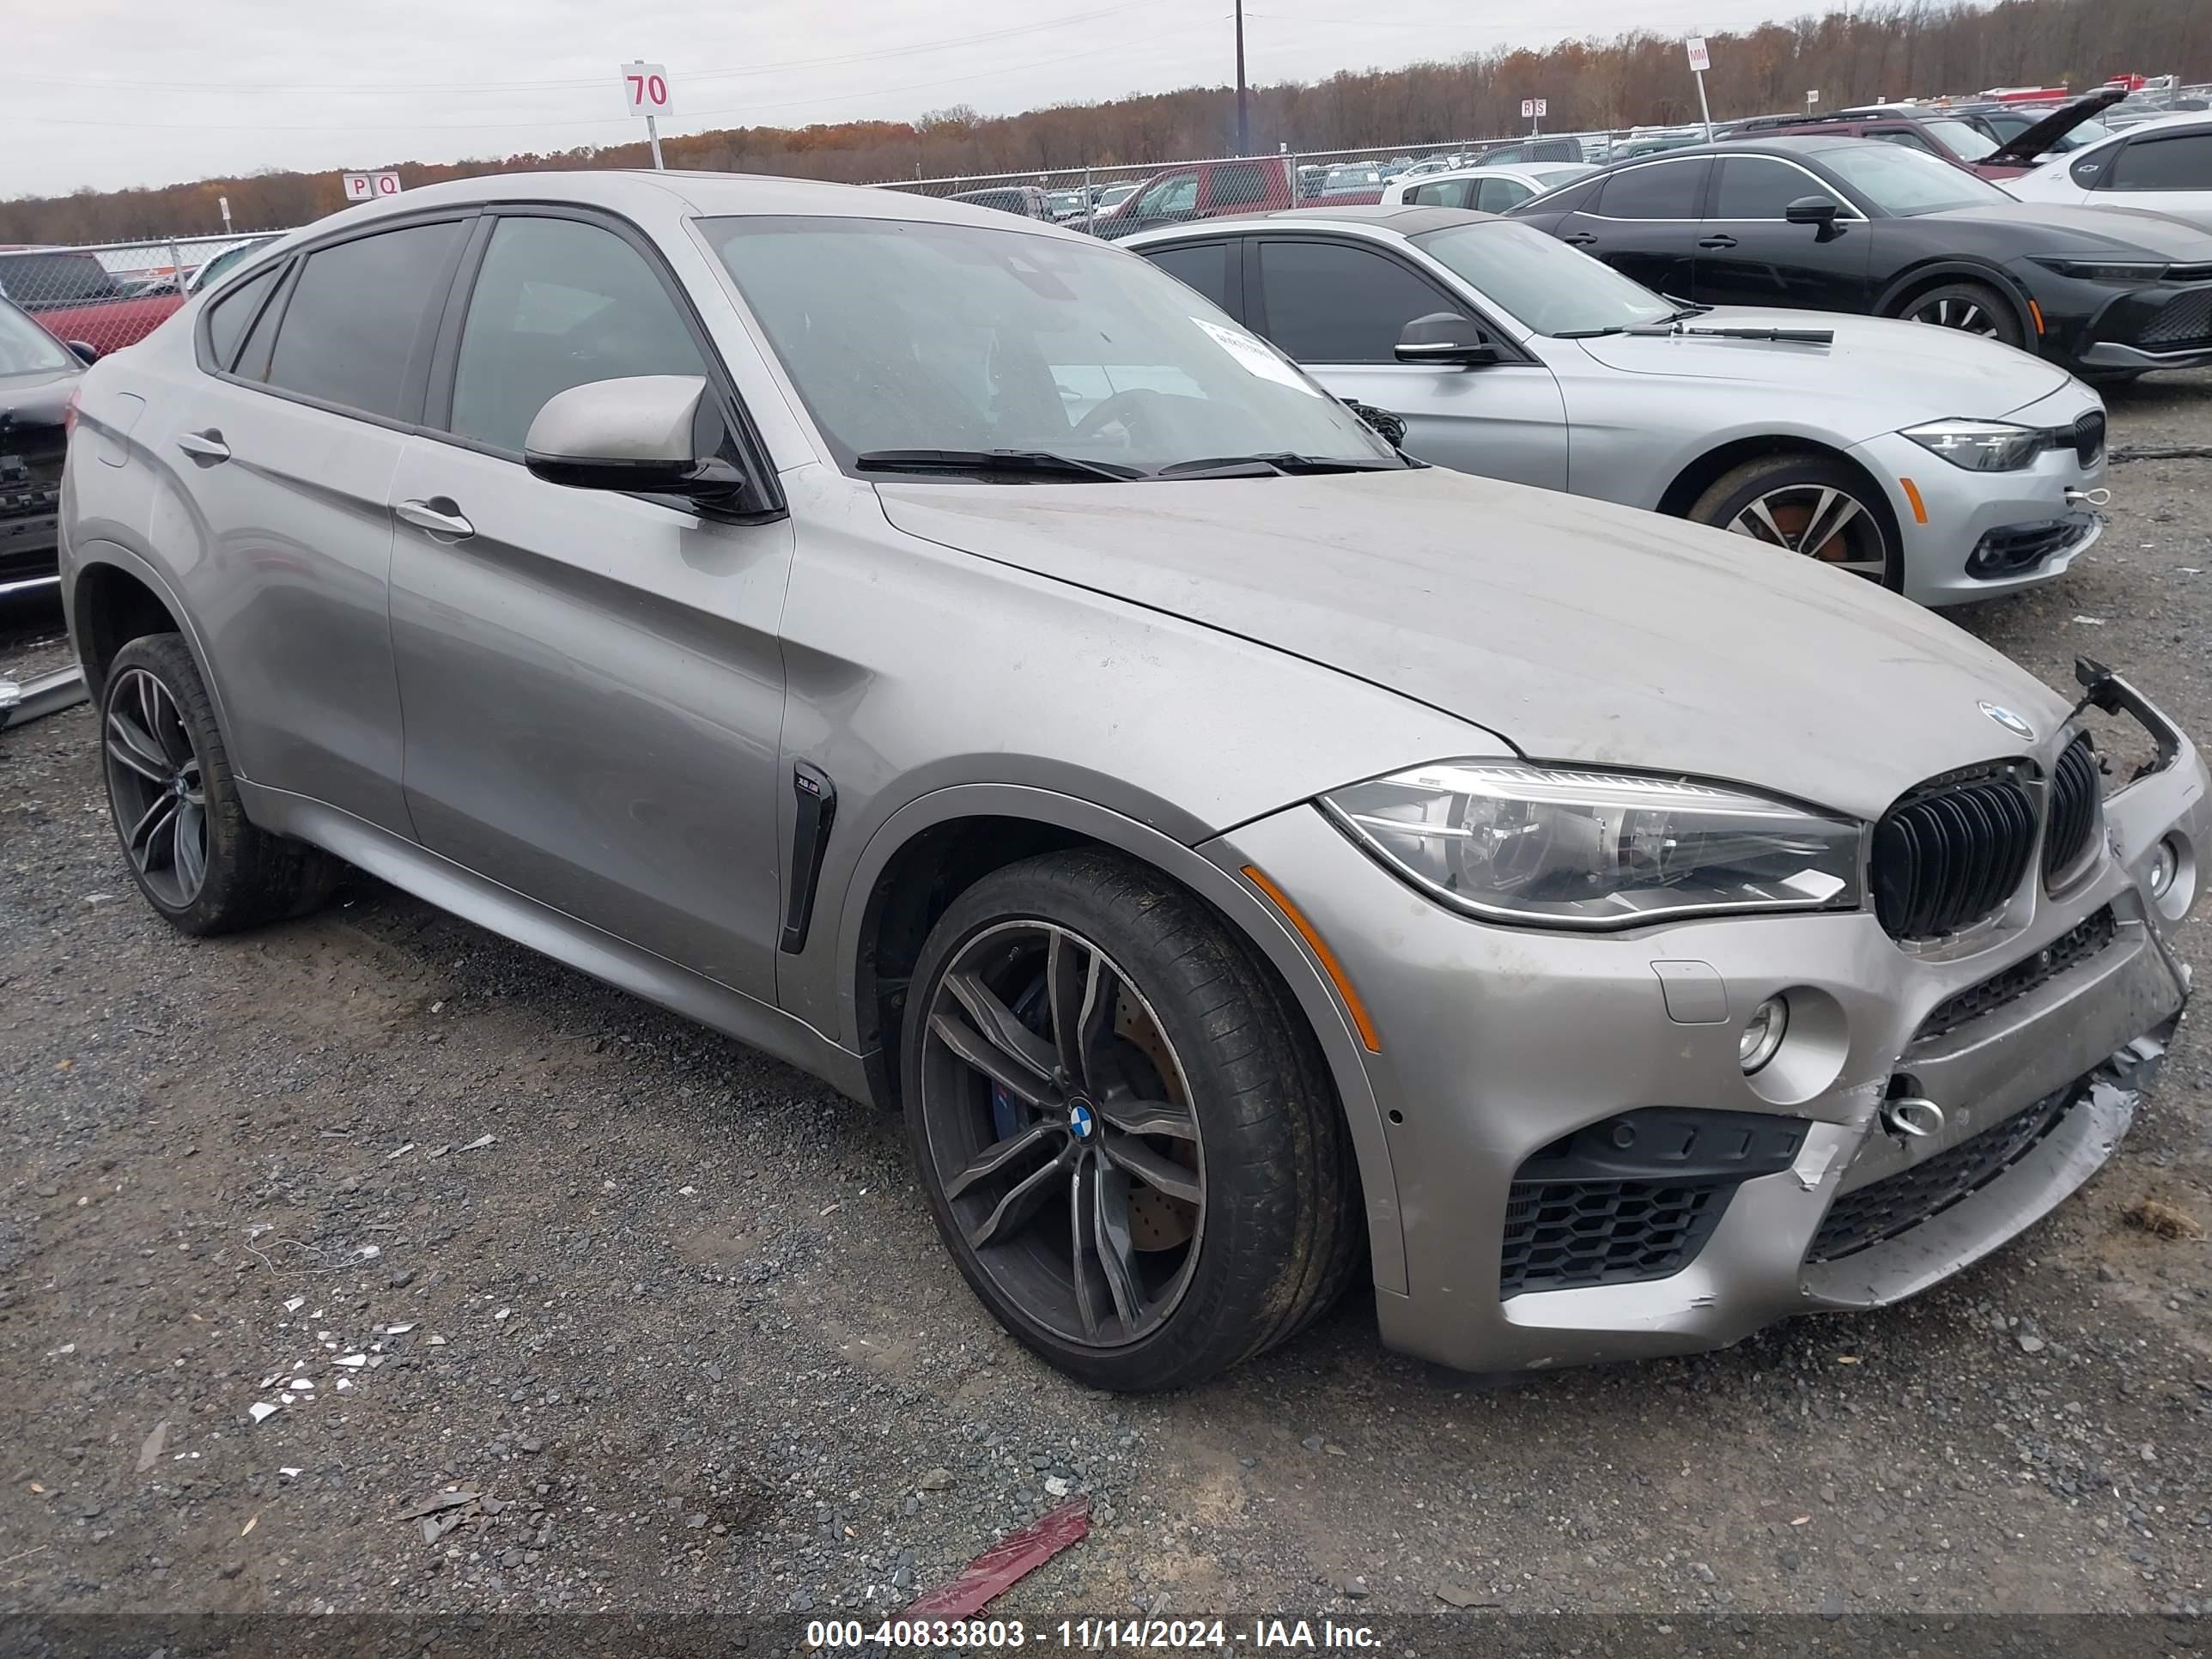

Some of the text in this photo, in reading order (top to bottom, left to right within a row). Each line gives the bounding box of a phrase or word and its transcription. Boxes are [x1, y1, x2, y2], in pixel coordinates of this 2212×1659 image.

[627, 75, 667, 105] 70
[1524, 102, 1544, 114] R S
[354, 176, 398, 195] P Q
